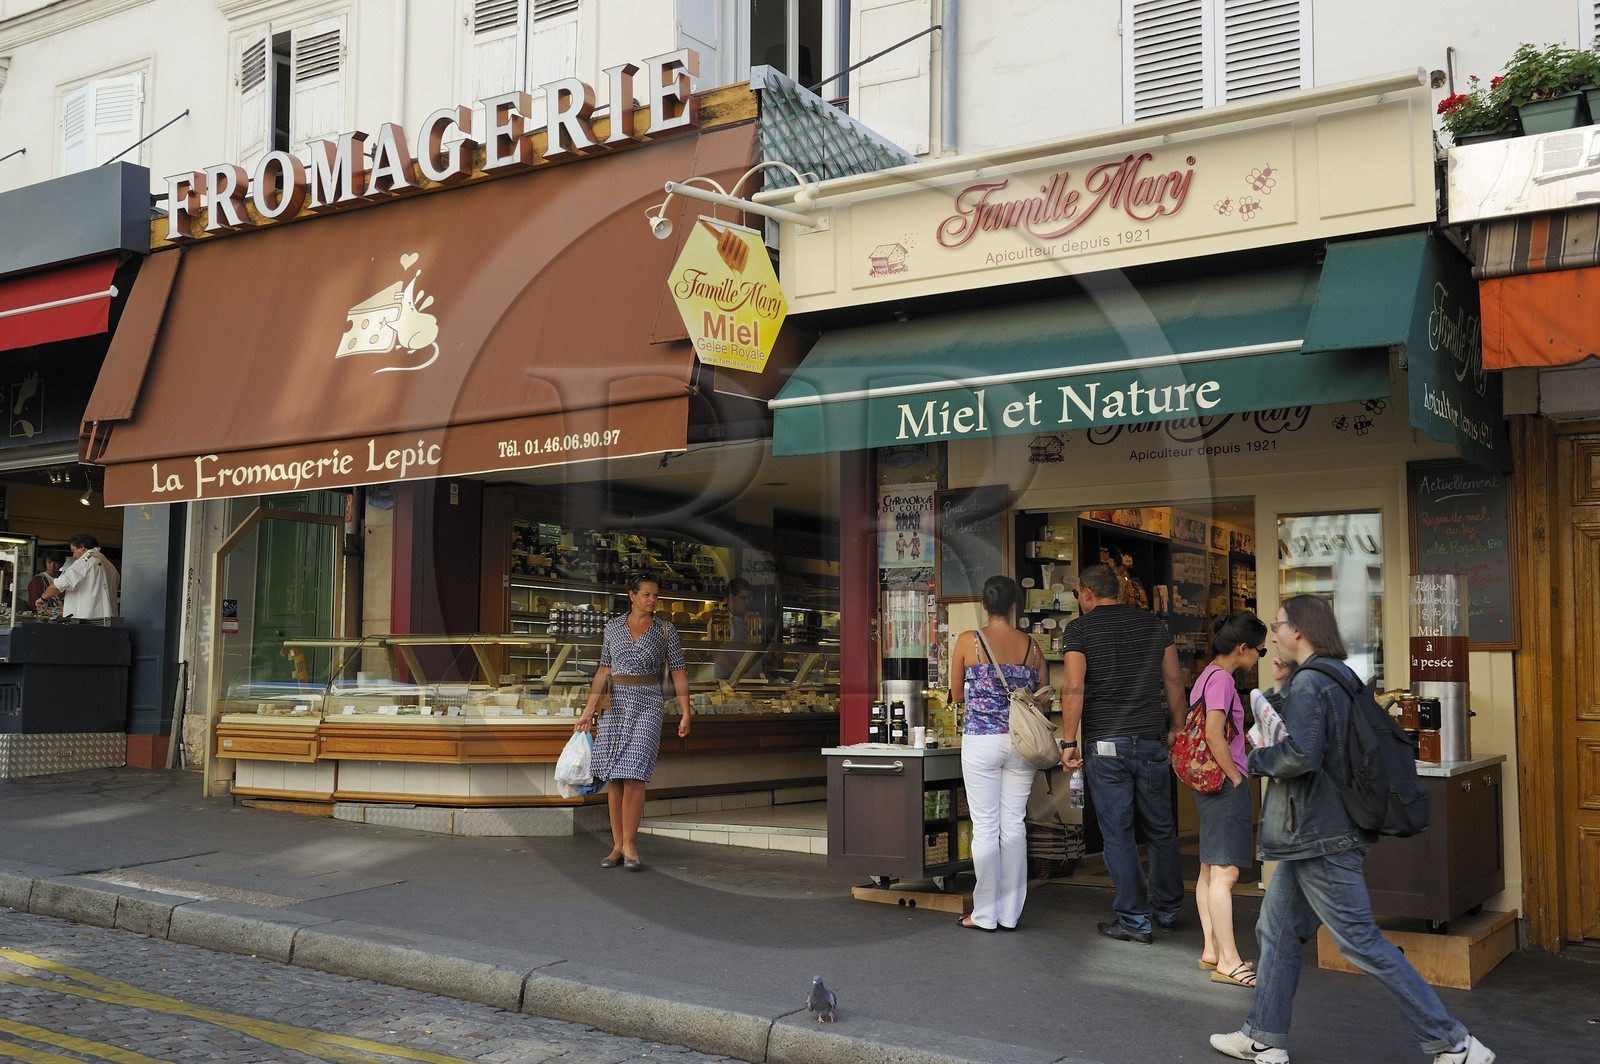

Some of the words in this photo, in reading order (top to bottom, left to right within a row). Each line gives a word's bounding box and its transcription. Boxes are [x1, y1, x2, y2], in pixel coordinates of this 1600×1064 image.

[163, 48, 700, 240] FROMAGERIE
[936, 171, 1086, 249] Famille
[985, 242, 1057, 265] Apiculteur
[1061, 234, 1110, 255] depuis
[1116, 227, 1152, 245] 1921
[674, 268, 739, 304] Famille
[727, 281, 782, 320] Mary
[703, 310, 759, 347] Miel
[696, 337, 728, 355] Gelée
[730, 343, 766, 361] Royale
[702, 355, 762, 371] www.famillemary.fr
[896, 389, 987, 440] Miel
[1002, 392, 1042, 428] et
[1057, 378, 1222, 424] Nature
[497, 440, 521, 459] Tél.
[524, 429, 621, 455] 01.46.06.90.97
[1129, 446, 1194, 461] Apiculteur
[1197, 442, 1242, 458] depuis
[1246, 439, 1277, 452] 1921
[151, 463, 184, 494] La
[194, 450, 354, 498] Fromagerie
[366, 438, 442, 478] Lepic
[899, 503, 934, 512] COUPLE
[1487, 538, 1503, 549] Bio
[1418, 625, 1444, 637] Miel
[1426, 641, 1433, 652] à
[1411, 655, 1419, 667] la
[1420, 657, 1454, 671] pesée
